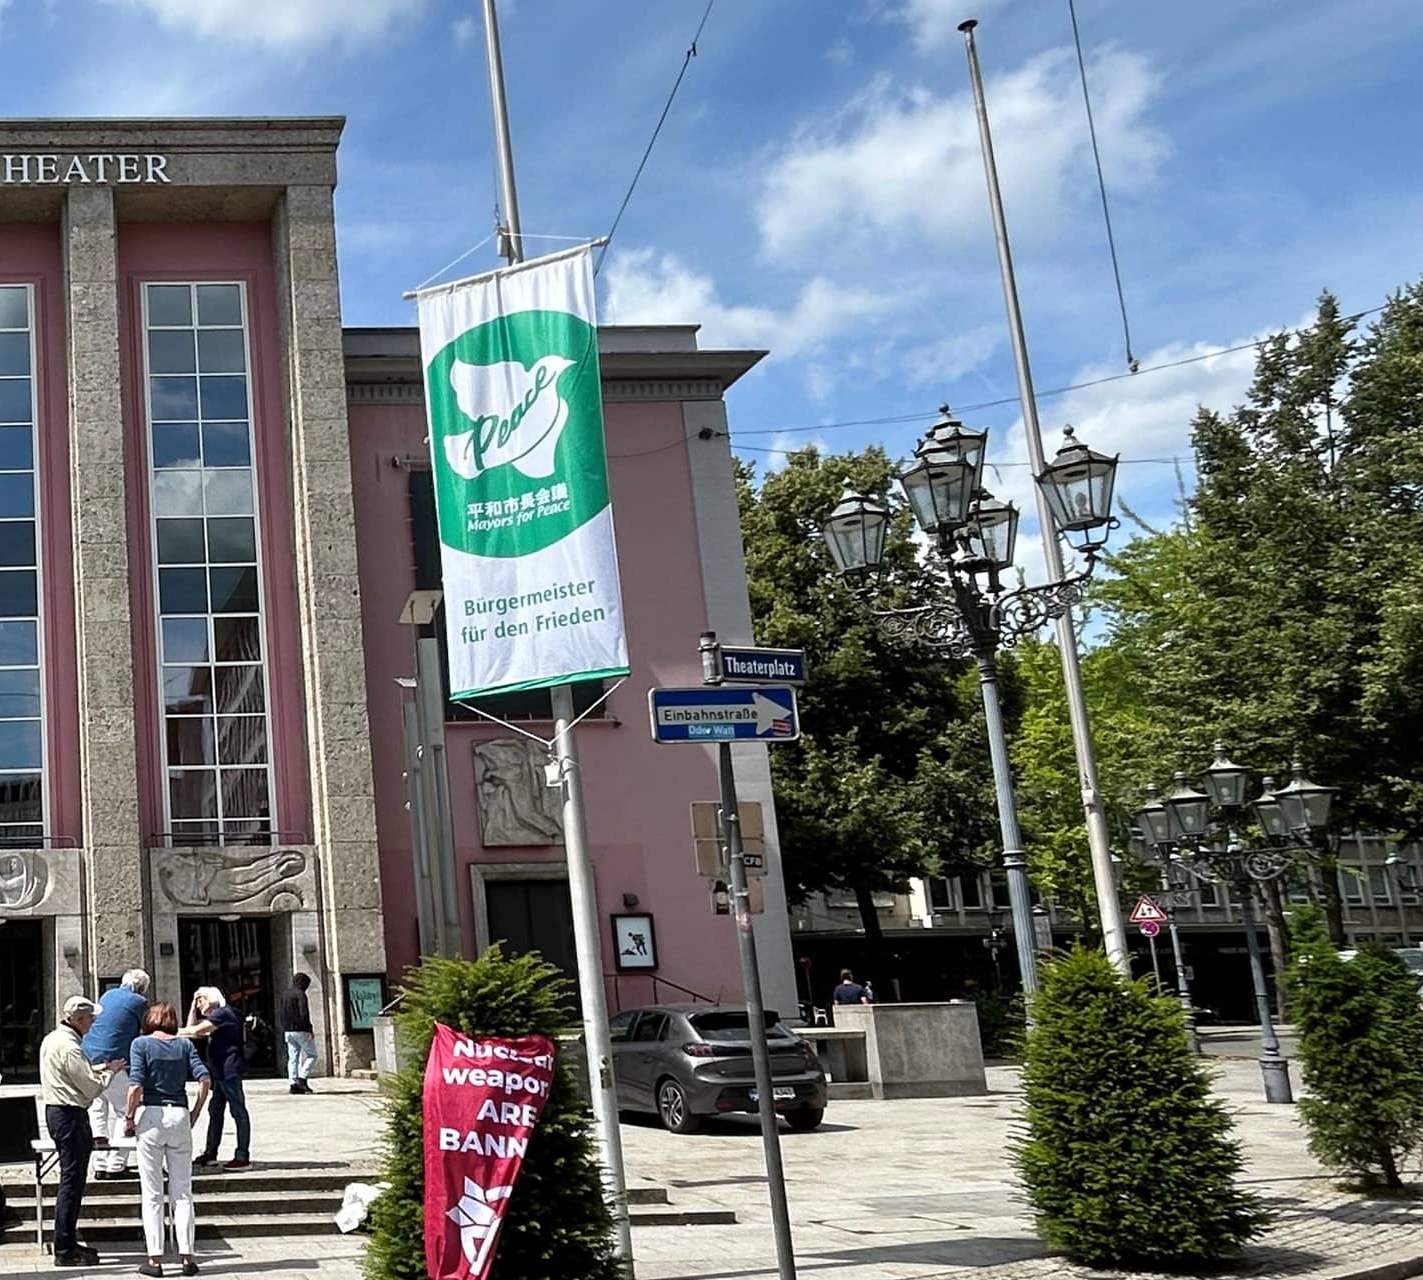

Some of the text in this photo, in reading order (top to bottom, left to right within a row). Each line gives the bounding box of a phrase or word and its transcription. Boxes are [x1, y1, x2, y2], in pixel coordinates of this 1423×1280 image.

[464, 365, 557, 471] Peace
[467, 500, 571, 532] Mayors for Peace
[464, 580, 596, 616] Bürgermeister
[461, 606, 606, 644] für den Frieden
[724, 656, 796, 678] Theaterplatz
[664, 708, 758, 721] Einbahnstraße
[477, 1098, 538, 1129] ARE
